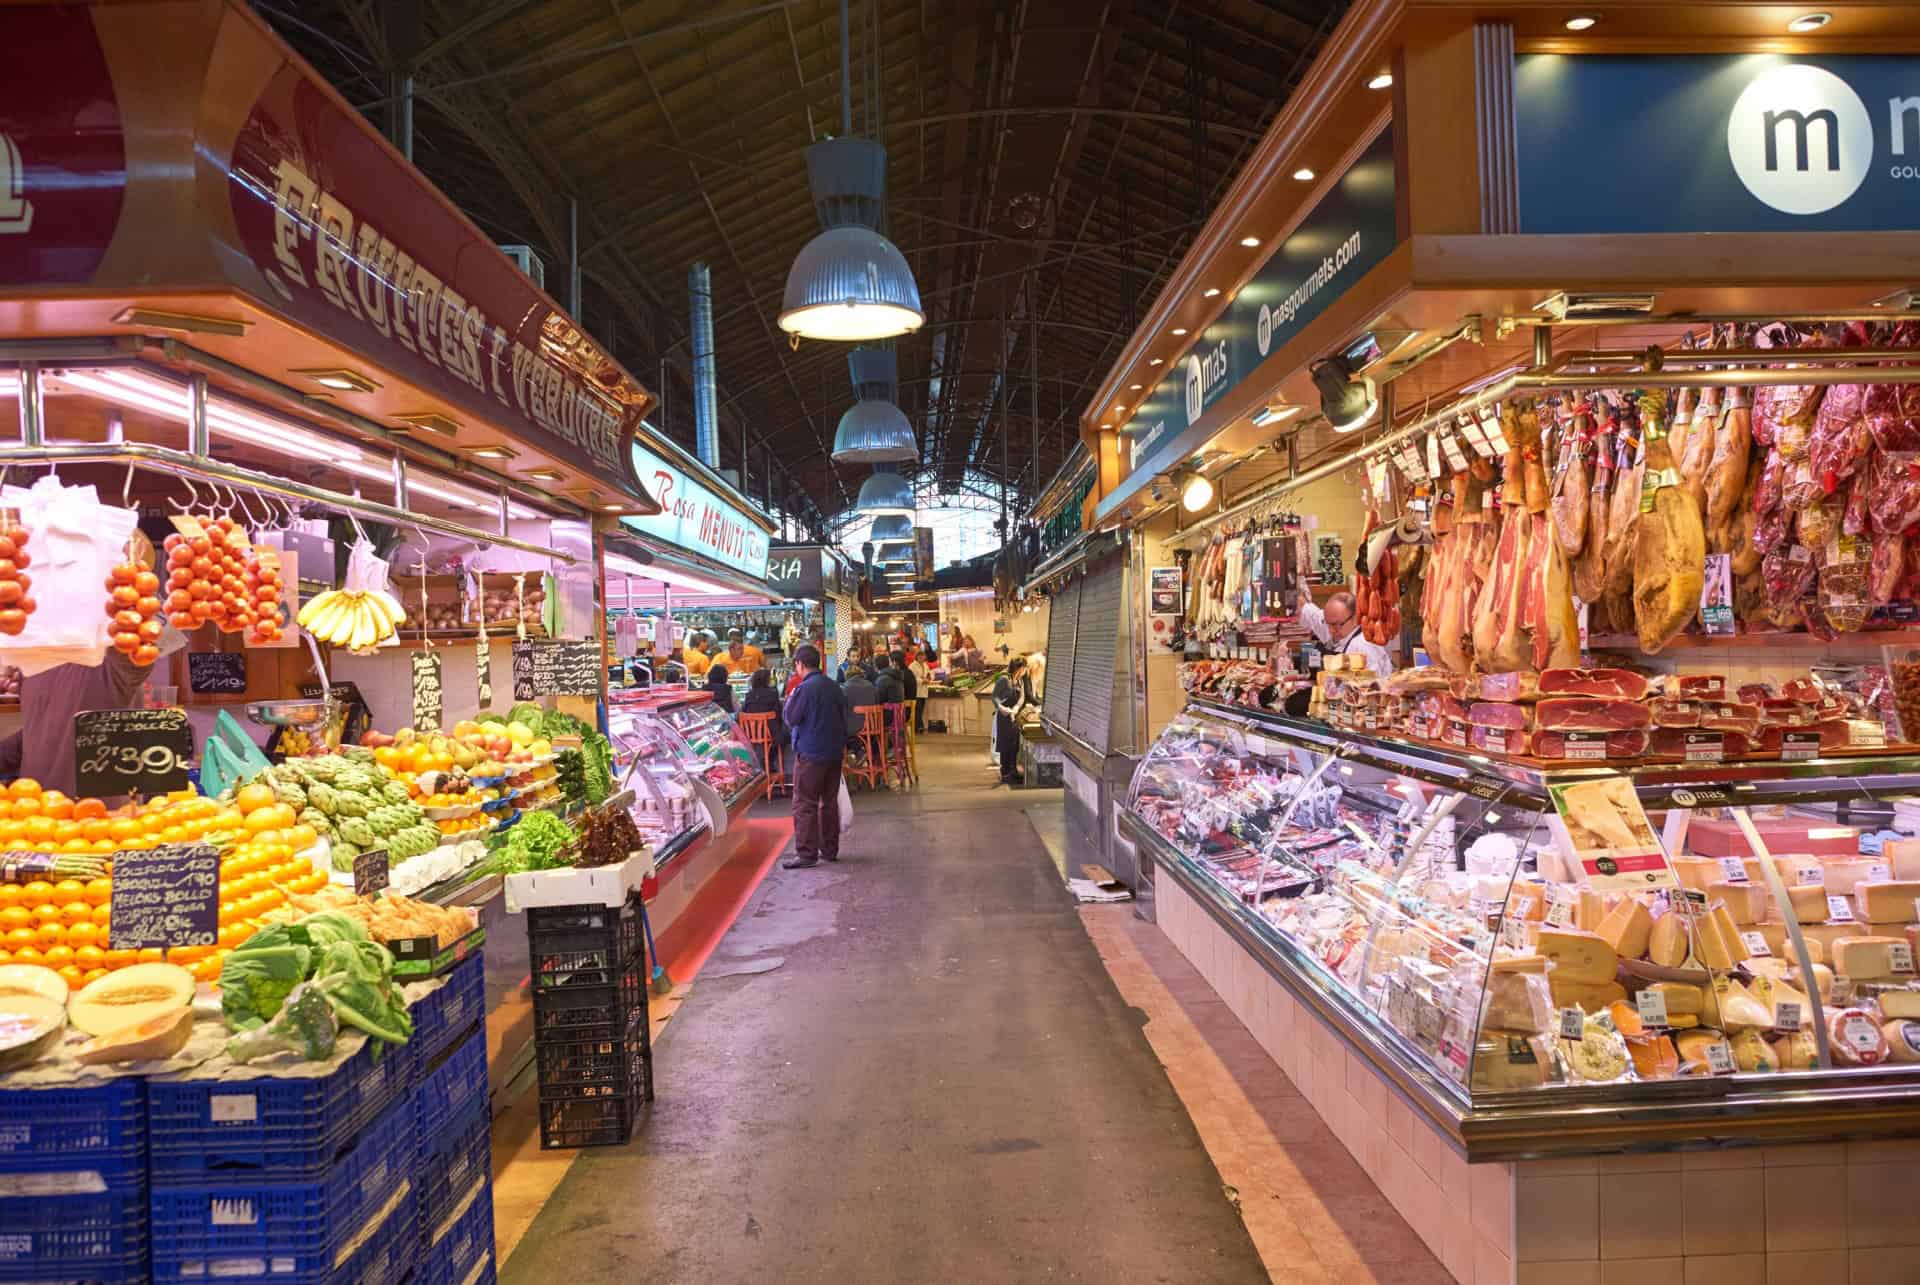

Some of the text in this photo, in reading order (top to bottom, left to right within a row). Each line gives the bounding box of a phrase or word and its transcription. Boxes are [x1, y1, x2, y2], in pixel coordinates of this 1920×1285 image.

[1763, 109, 1840, 171] m
[1271, 231, 1360, 332] masgourmets.com
[1202, 339, 1227, 393] mas
[654, 470, 696, 519] Rosa
[699, 502, 745, 560] MENUTS
[1694, 790, 1726, 800] mas
